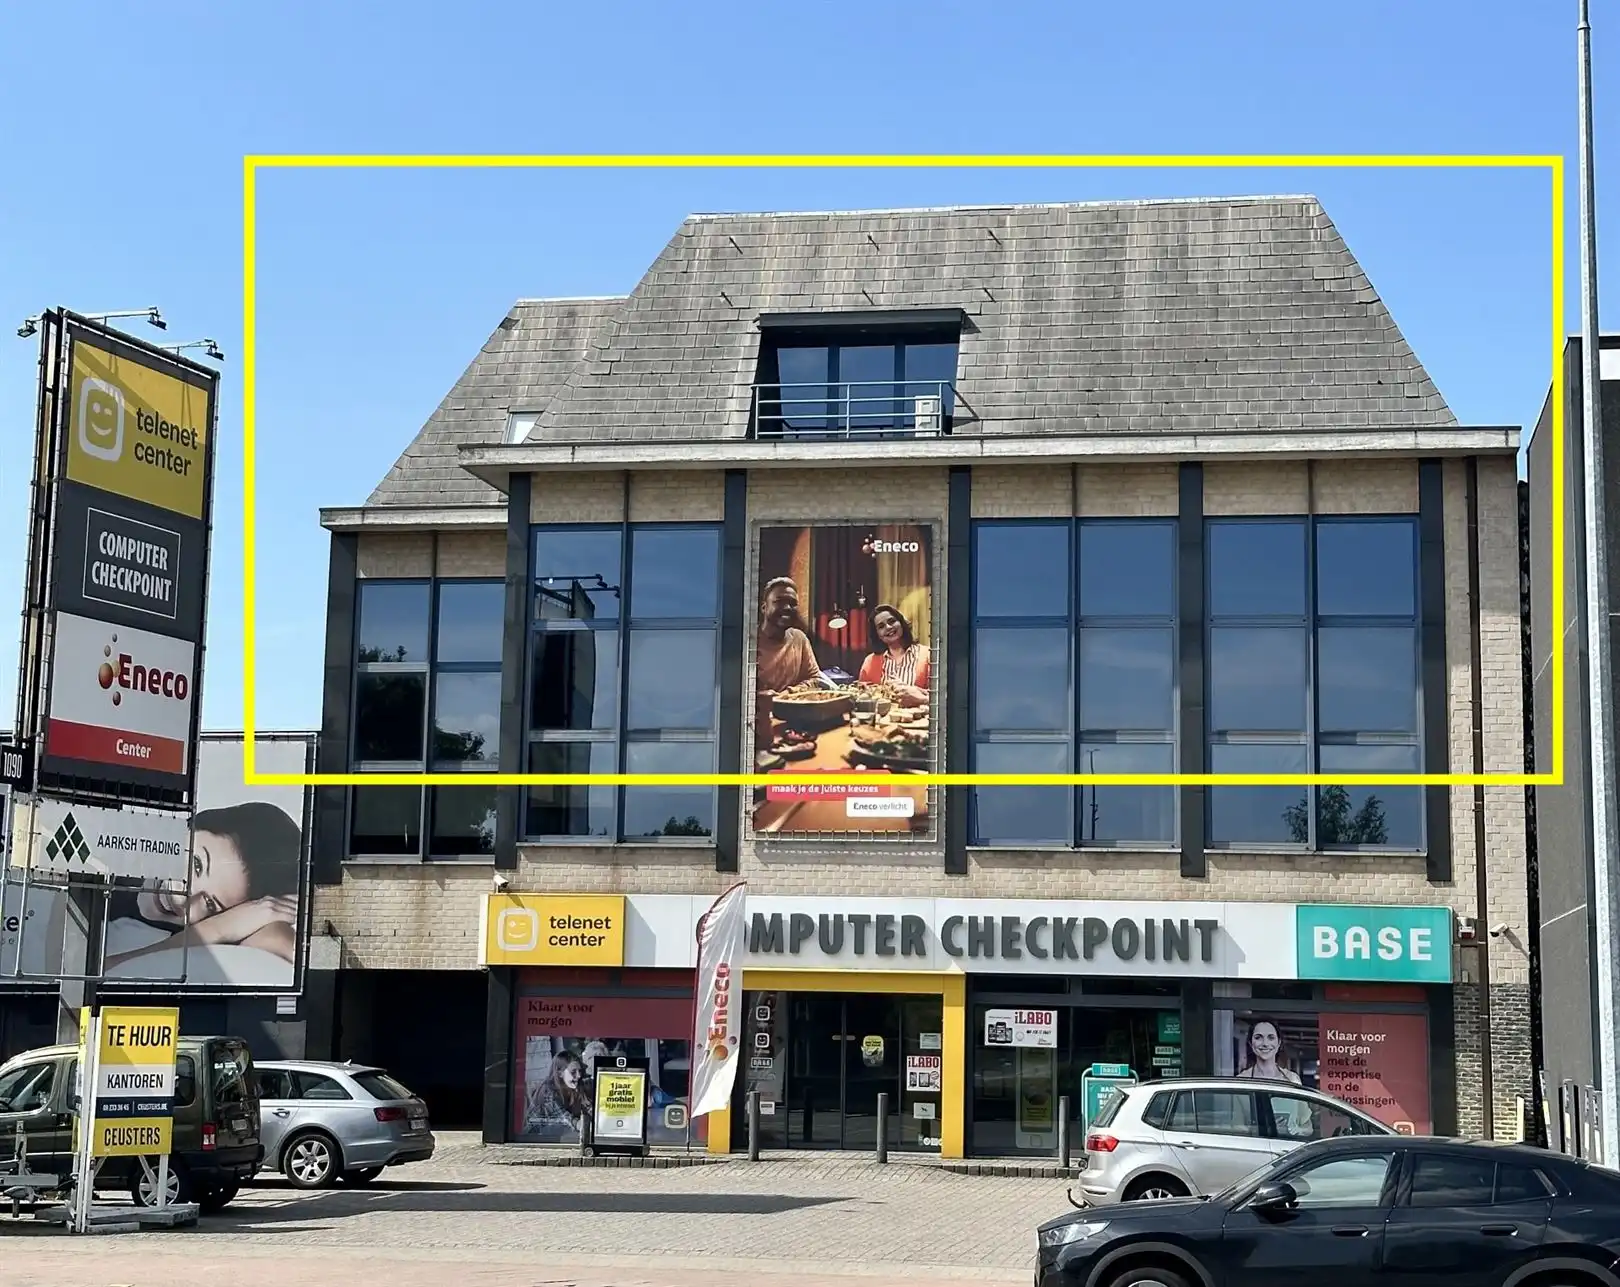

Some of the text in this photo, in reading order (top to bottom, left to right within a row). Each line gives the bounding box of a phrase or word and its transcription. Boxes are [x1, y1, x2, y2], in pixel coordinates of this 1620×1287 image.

[136, 408, 198, 450] telenet
[134, 441, 192, 476] center
[99, 531, 168, 571] COMPUTER
[873, 539, 919, 553] Eneco
[92, 560, 172, 602] CHECKPOINT
[118, 653, 188, 701] Eneco
[116, 738, 152, 759] Center
[3, 752, 23, 779] 1090
[772, 784, 796, 793] maak
[808, 784, 819, 793] de
[848, 784, 879, 793] keuzes
[853, 802, 878, 810] Eneco
[97, 833, 180, 856] AARKSH TRADING
[550, 915, 611, 929] telenet
[549, 931, 606, 947] center
[696, 911, 1219, 962] MPUTER CHECKPOINT
[1313, 926, 1433, 962] BASE
[528, 1000, 594, 1013] Klaar voor
[708, 962, 730, 1041] Eneco
[527, 1016, 573, 1028] morgen
[1014, 1011, 1052, 1025] iLABO
[107, 1025, 172, 1047] TE HUUR
[1326, 1029, 1387, 1042] Klaar voor
[1327, 1045, 1370, 1056] morgen
[908, 1056, 940, 1068] iLABO
[1327, 1057, 1367, 1067] met de
[107, 1073, 164, 1089] KANTOREN
[1327, 1070, 1381, 1080] expertise
[1327, 1082, 1360, 1092] en de
[1332, 1094, 1396, 1107] lossingen
[104, 1127, 161, 1147] CEUSTERS
